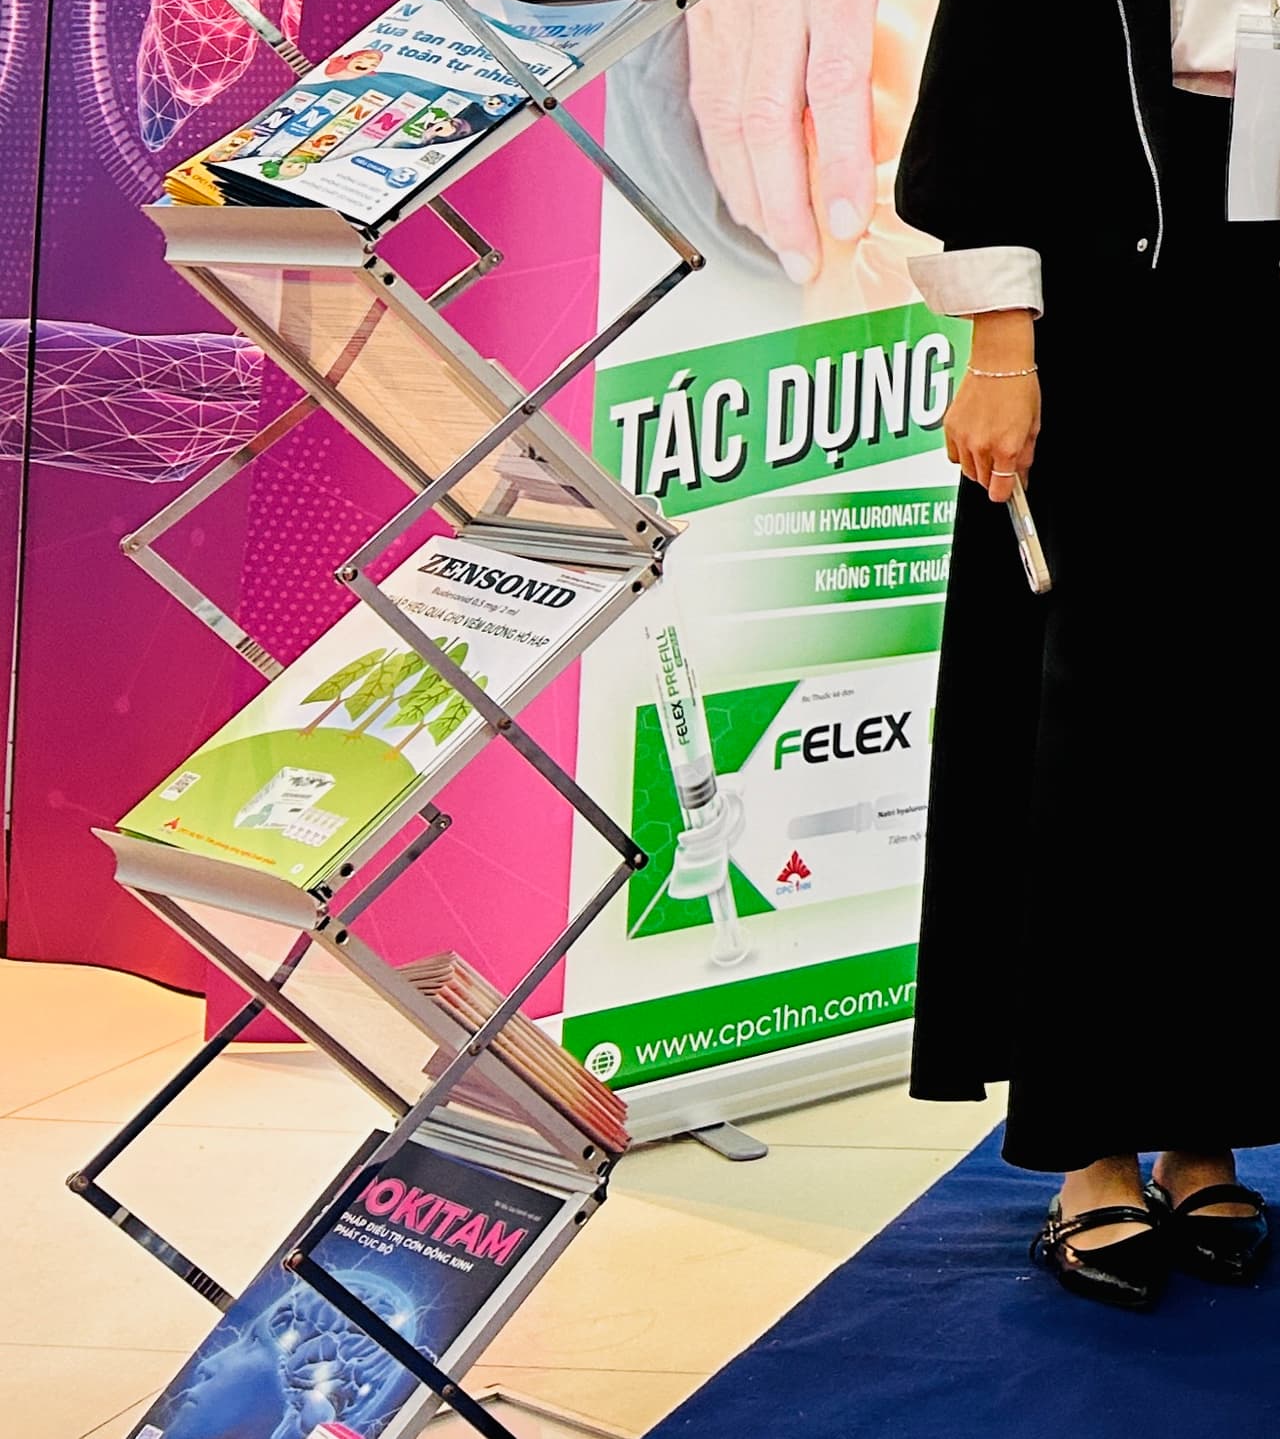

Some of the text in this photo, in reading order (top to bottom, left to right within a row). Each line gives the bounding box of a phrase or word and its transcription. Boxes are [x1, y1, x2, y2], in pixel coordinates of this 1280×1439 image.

[397, 45, 442, 66] toàn
[412, 30, 445, 47] tan
[610, 333, 954, 496] TÁC DỤNG
[753, 502, 931, 537] SODIUM HYALURONATE
[417, 553, 577, 609] ZENSONID
[815, 559, 906, 593] KHÔNG TIỆT
[656, 627, 690, 746] FELEX PREFILL
[774, 711, 912, 771] FELEX
[636, 980, 917, 1065] www.cpc1hn.com.vn
